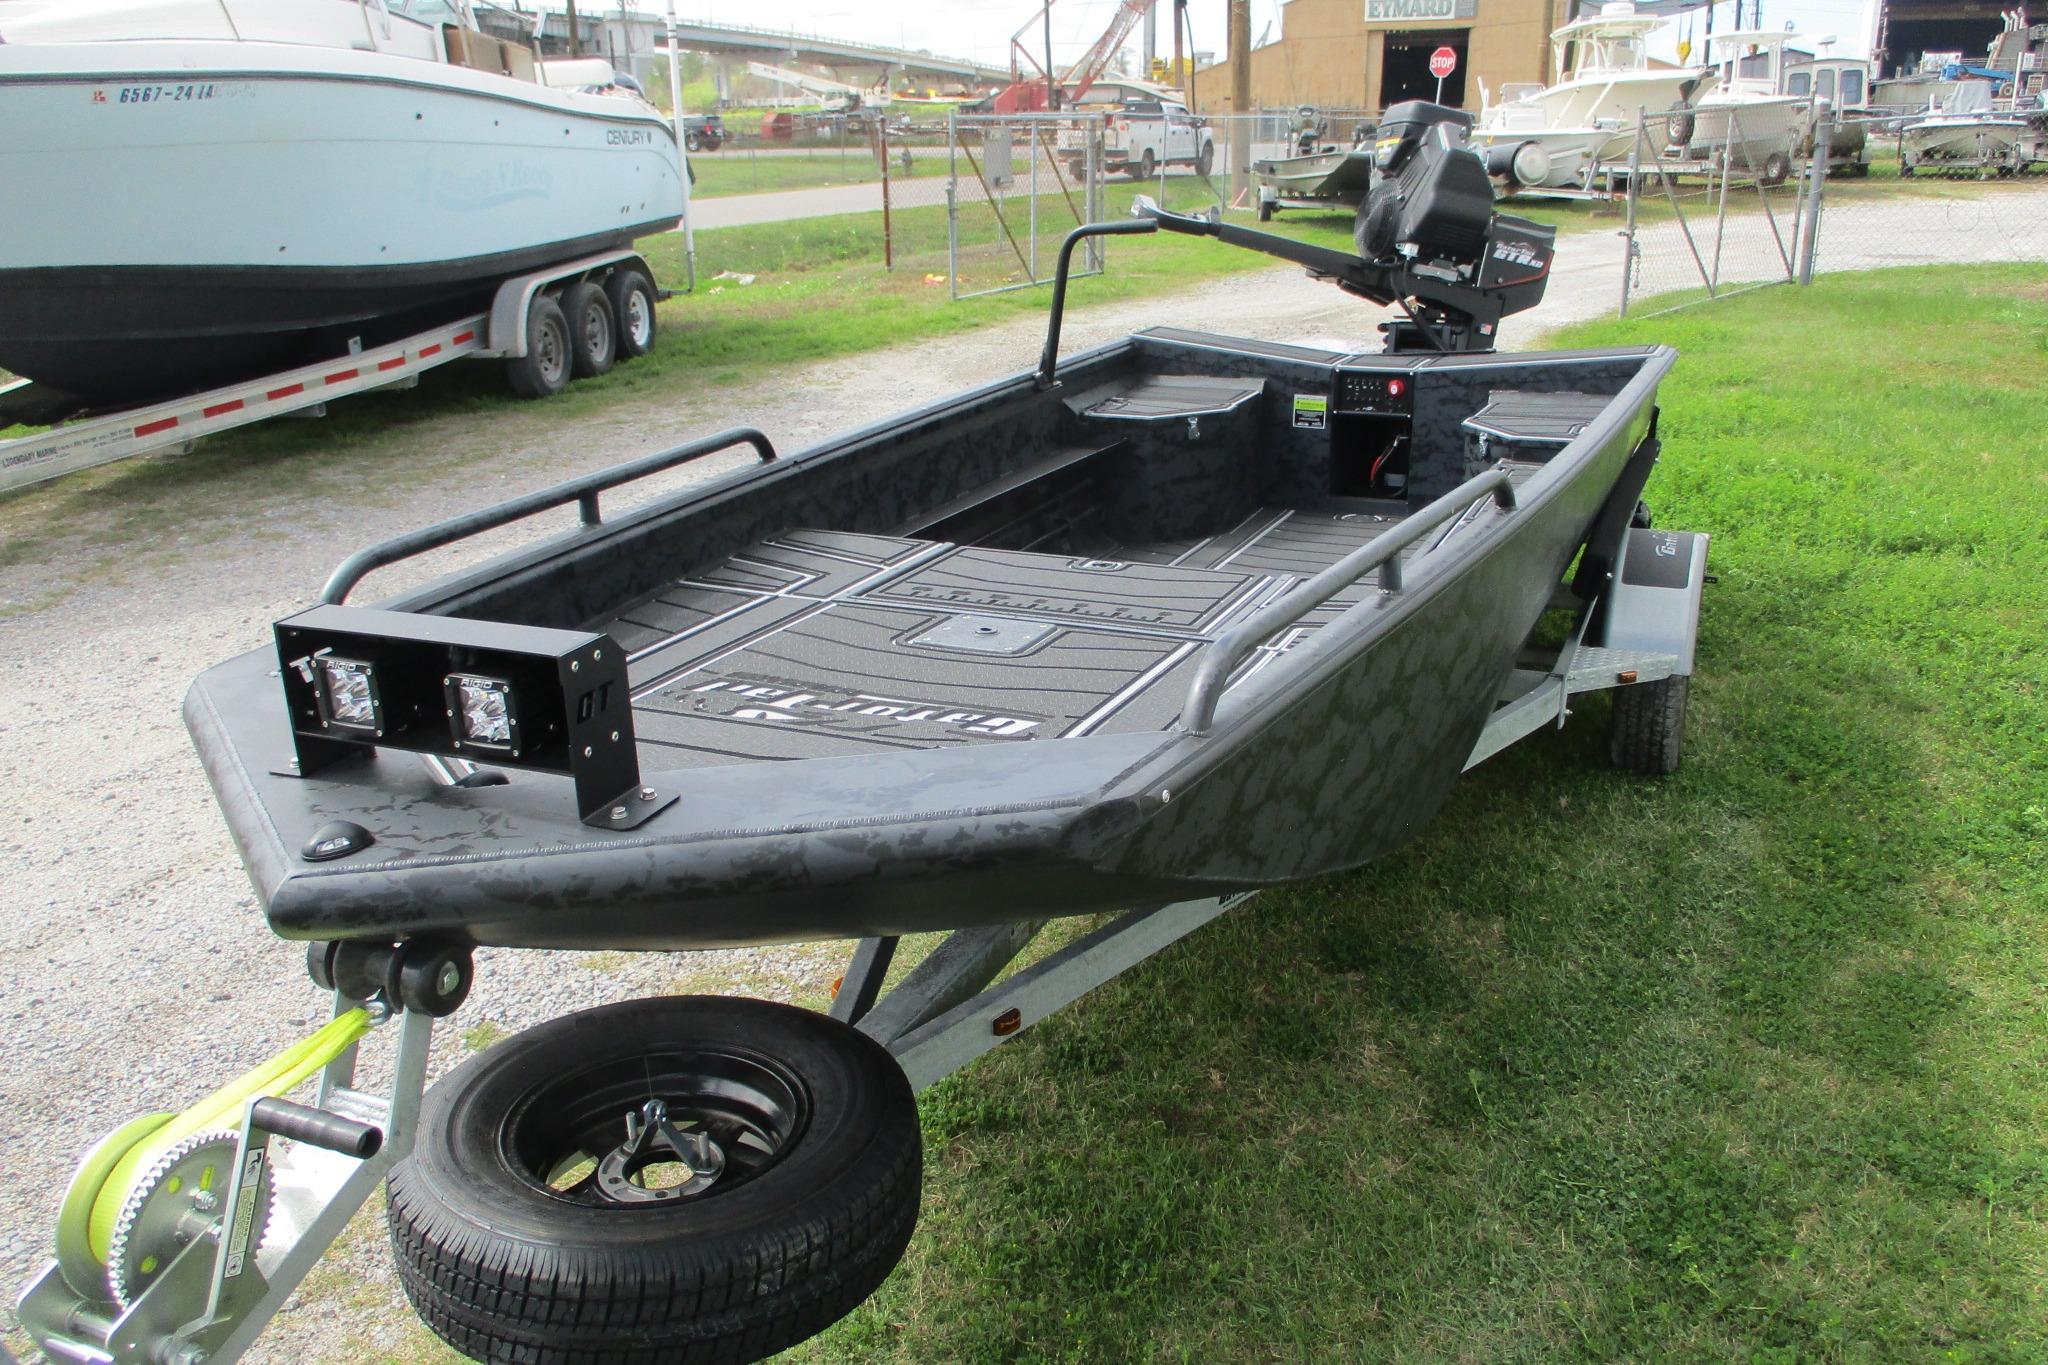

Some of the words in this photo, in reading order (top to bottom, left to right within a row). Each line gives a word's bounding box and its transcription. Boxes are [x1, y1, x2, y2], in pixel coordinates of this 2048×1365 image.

[1368, 0, 1453, 18] EYMARD
[1431, 57, 1454, 69] STOP
[607, 130, 644, 145] CENTURY
[1492, 249, 1532, 265] GTR
[1, 451, 37, 468] LEGENDARY
[326, 661, 356, 672] RIGID
[460, 679, 493, 689] RIGID
[577, 678, 617, 725] GT
